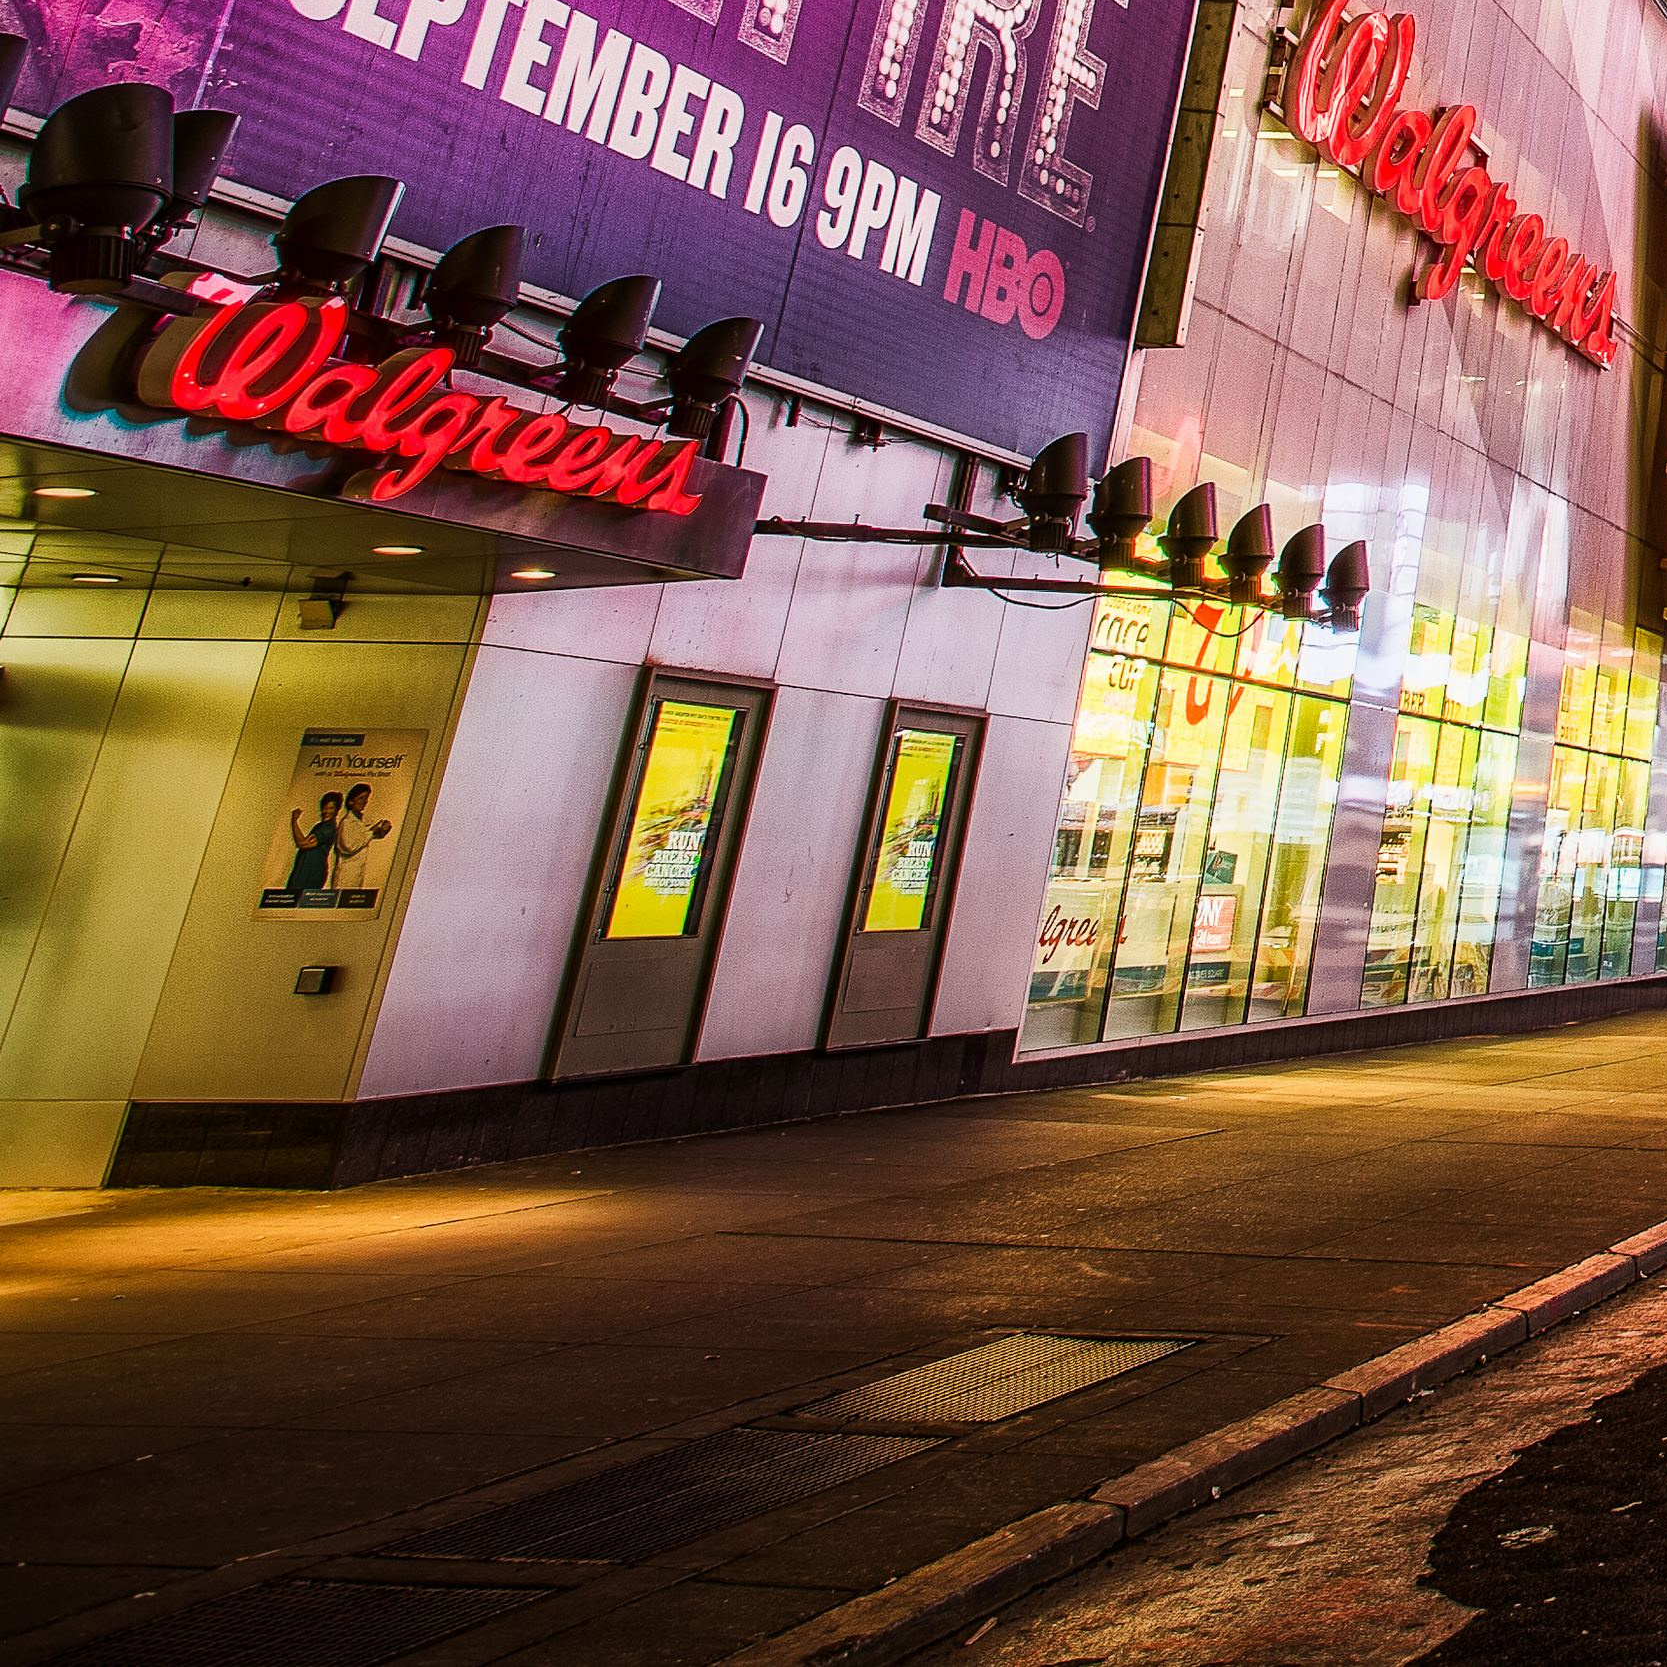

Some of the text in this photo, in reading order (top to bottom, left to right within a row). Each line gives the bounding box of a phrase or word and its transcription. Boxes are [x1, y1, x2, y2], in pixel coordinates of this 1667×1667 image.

[746, 110, 814, 230] 16
[820, 145, 943, 288] 9PM
[943, 208, 1070, 341] HBO
[172, 272, 703, 515] Walgreens
[309, 753, 405, 770] Arm Yourself
[651, 850, 698, 865] BREAST
[668, 830, 702, 852] RUN
